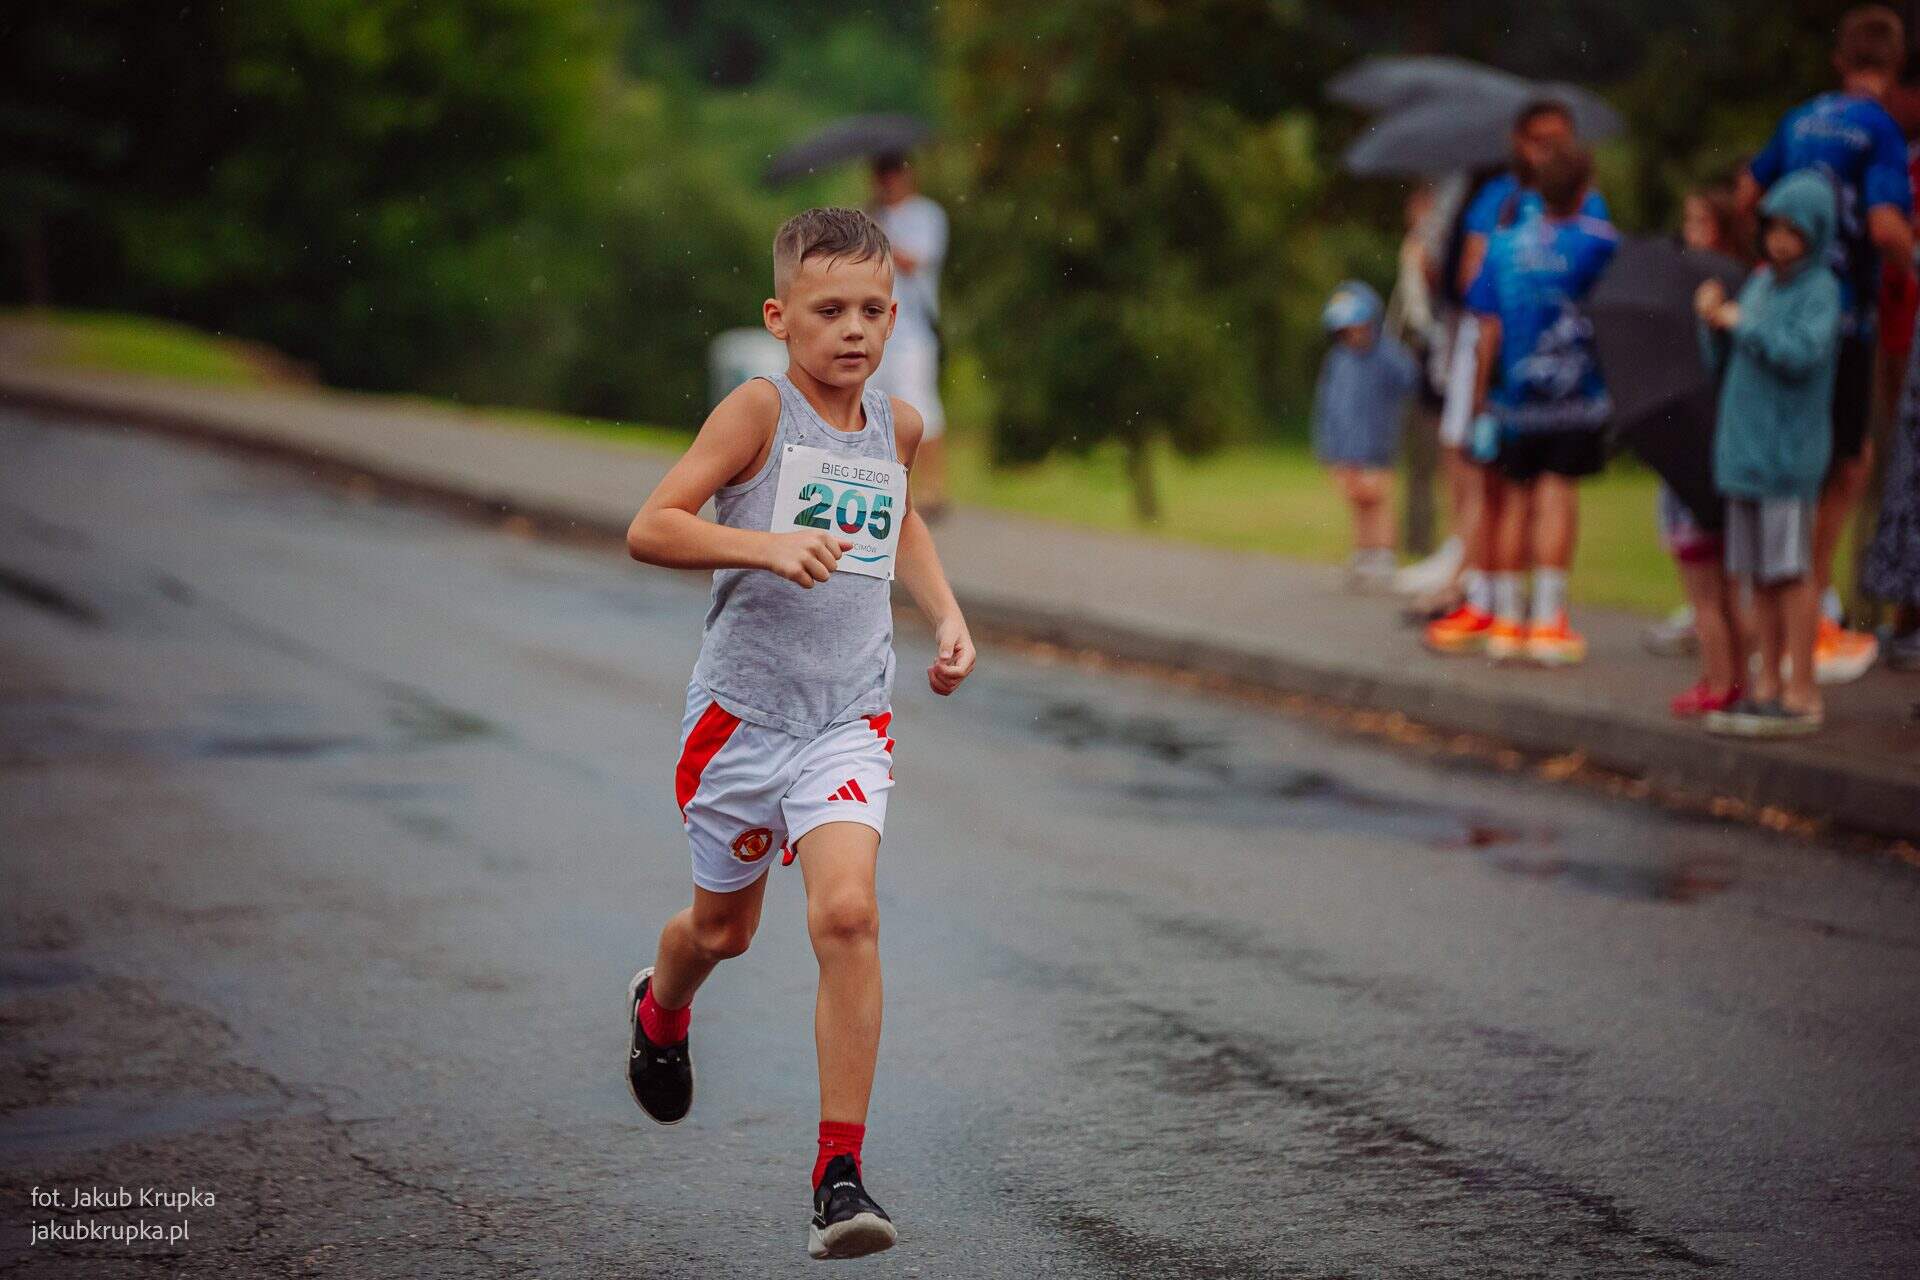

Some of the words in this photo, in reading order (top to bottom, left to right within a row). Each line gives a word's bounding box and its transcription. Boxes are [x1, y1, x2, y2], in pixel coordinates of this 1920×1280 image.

[821, 462, 849, 478] BIEG
[851, 467, 890, 485] JEZIOR
[793, 483, 893, 540] 205
